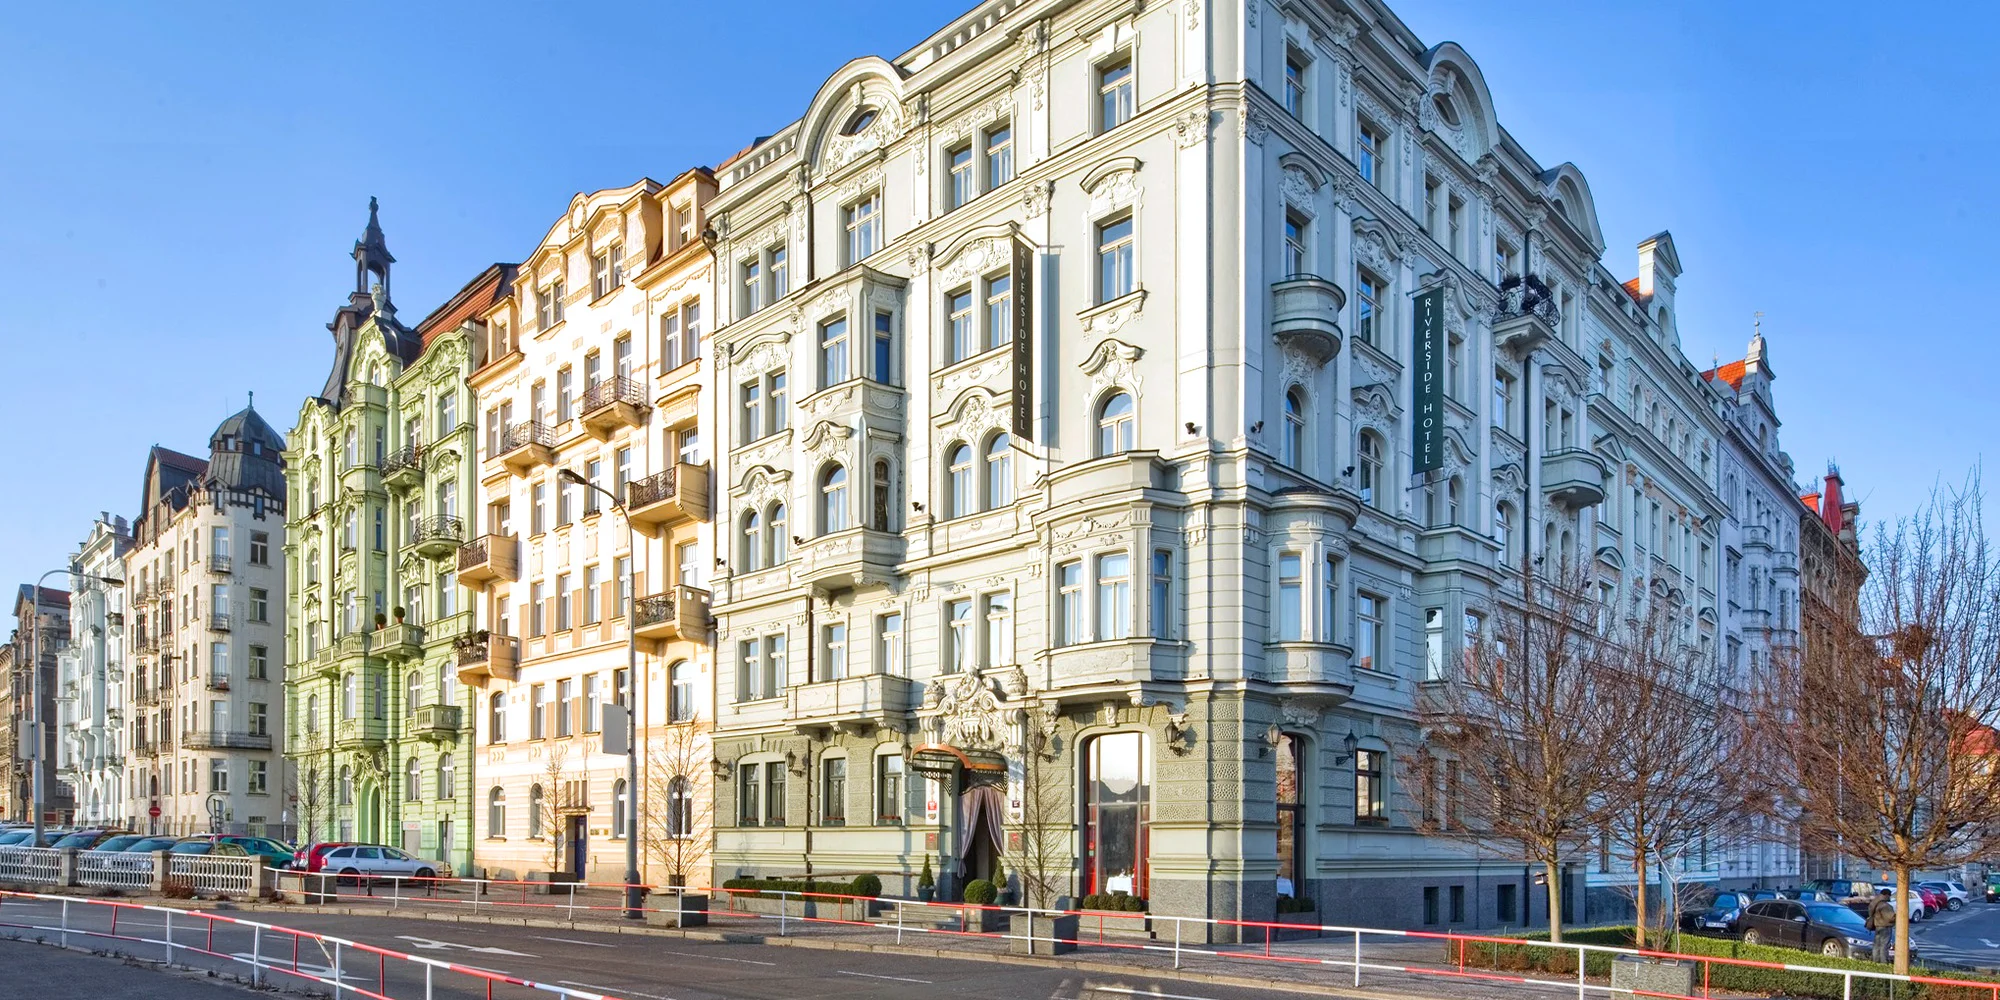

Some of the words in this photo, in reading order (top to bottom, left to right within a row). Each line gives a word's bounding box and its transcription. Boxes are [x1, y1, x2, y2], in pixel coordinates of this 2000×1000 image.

[1019, 246, 1027, 353] RIVERSIDE
[1424, 297, 1432, 394] RIVERSIDE
[1019, 363, 1027, 430] HOTEL
[1423, 402, 1432, 464] HOTEL
